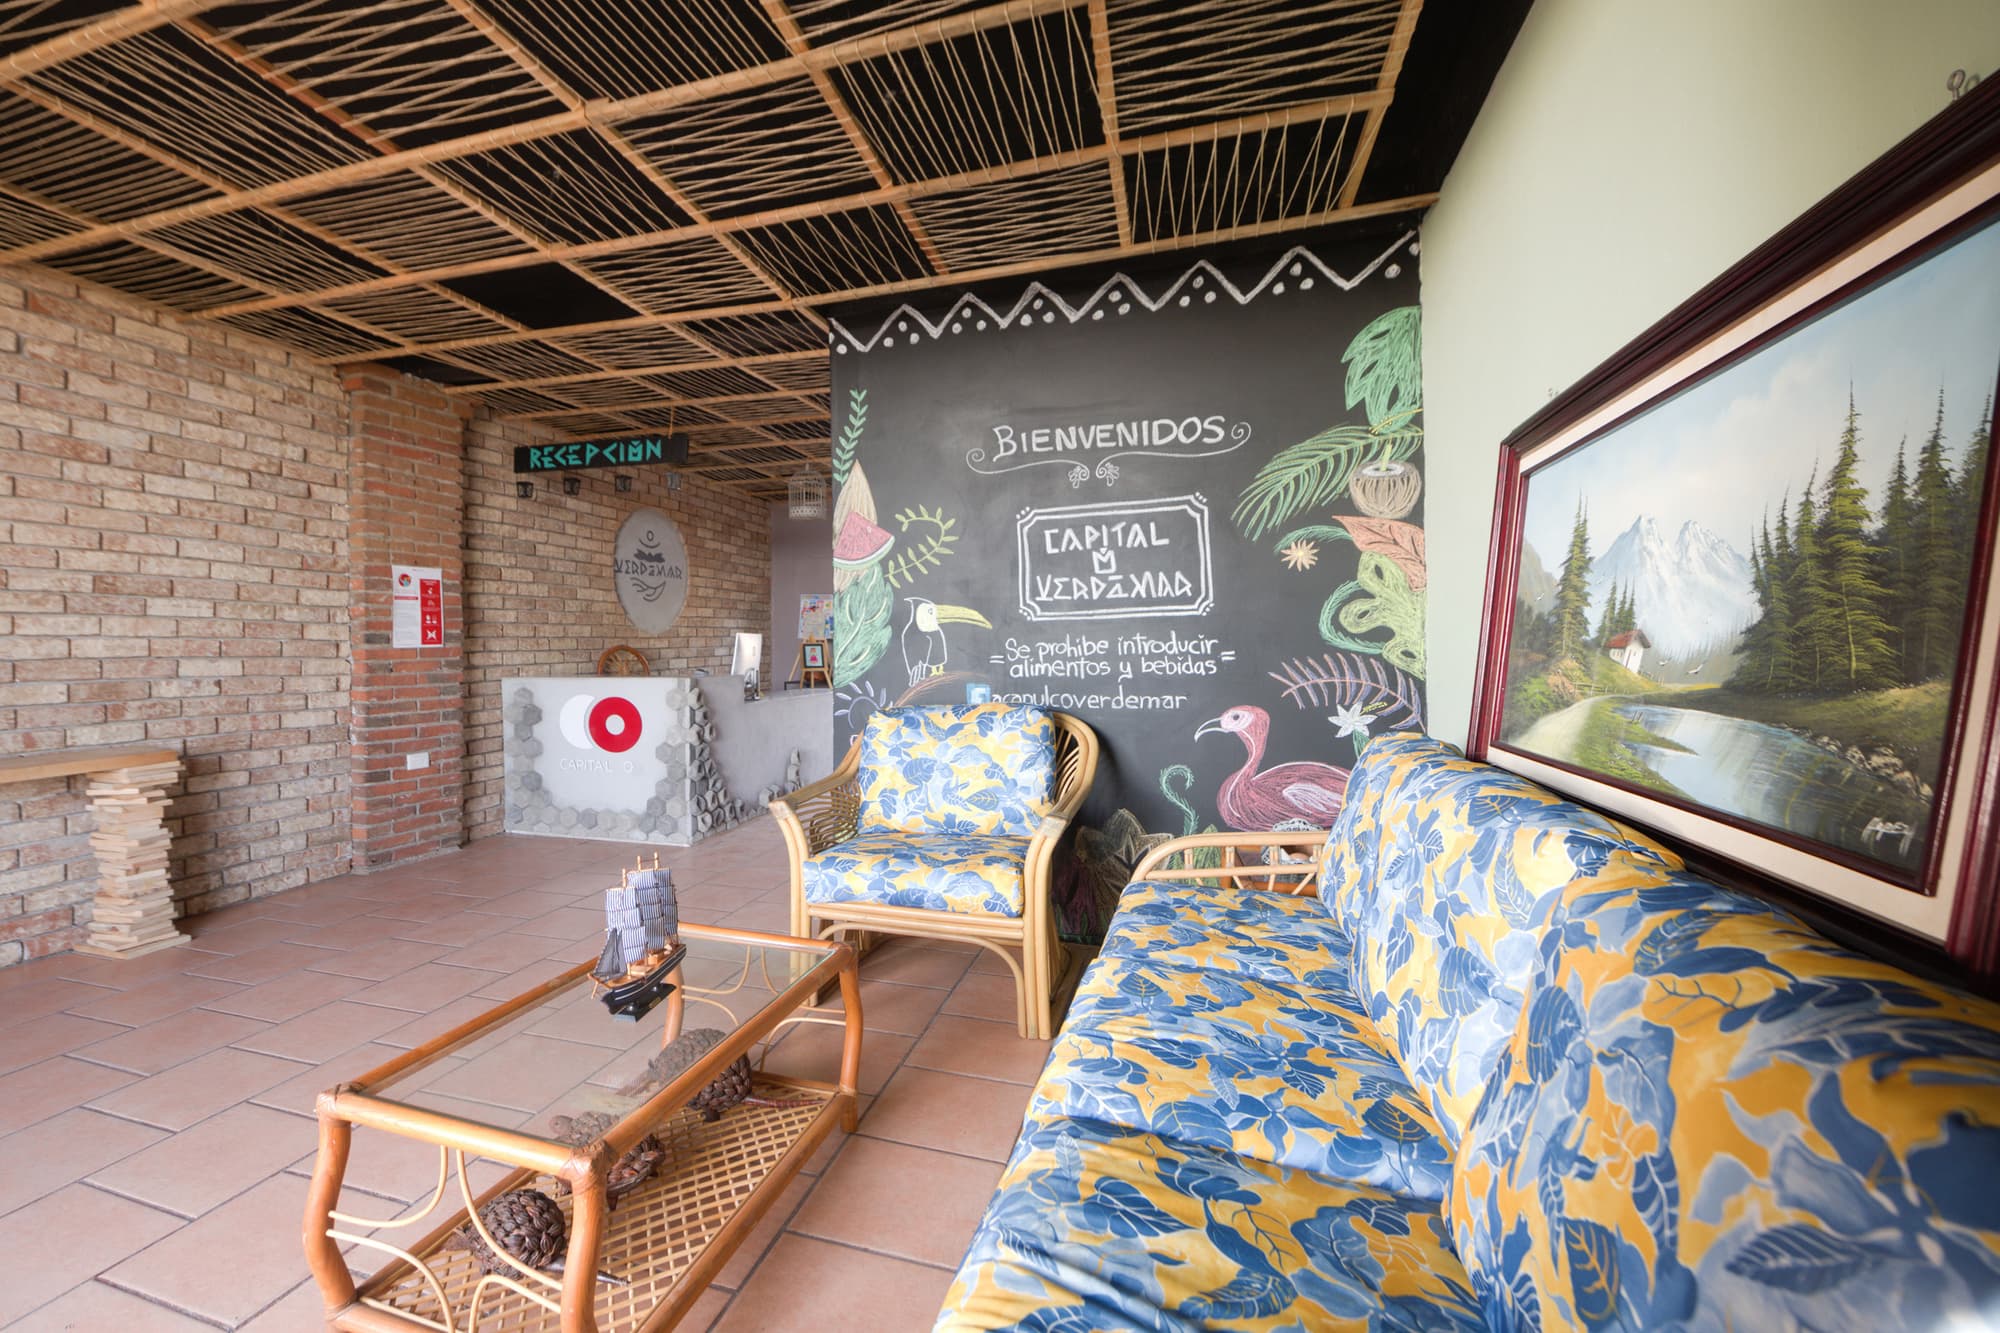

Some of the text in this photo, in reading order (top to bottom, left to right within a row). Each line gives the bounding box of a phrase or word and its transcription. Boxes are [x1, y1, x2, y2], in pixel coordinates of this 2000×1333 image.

[993, 416, 1225, 462] BIENVENIDOS
[1044, 522, 1170, 554] CAPITAL
[1005, 630, 1219, 661] Se prohibe introducir
[1010, 655, 1218, 682] alimentos y bebidas
